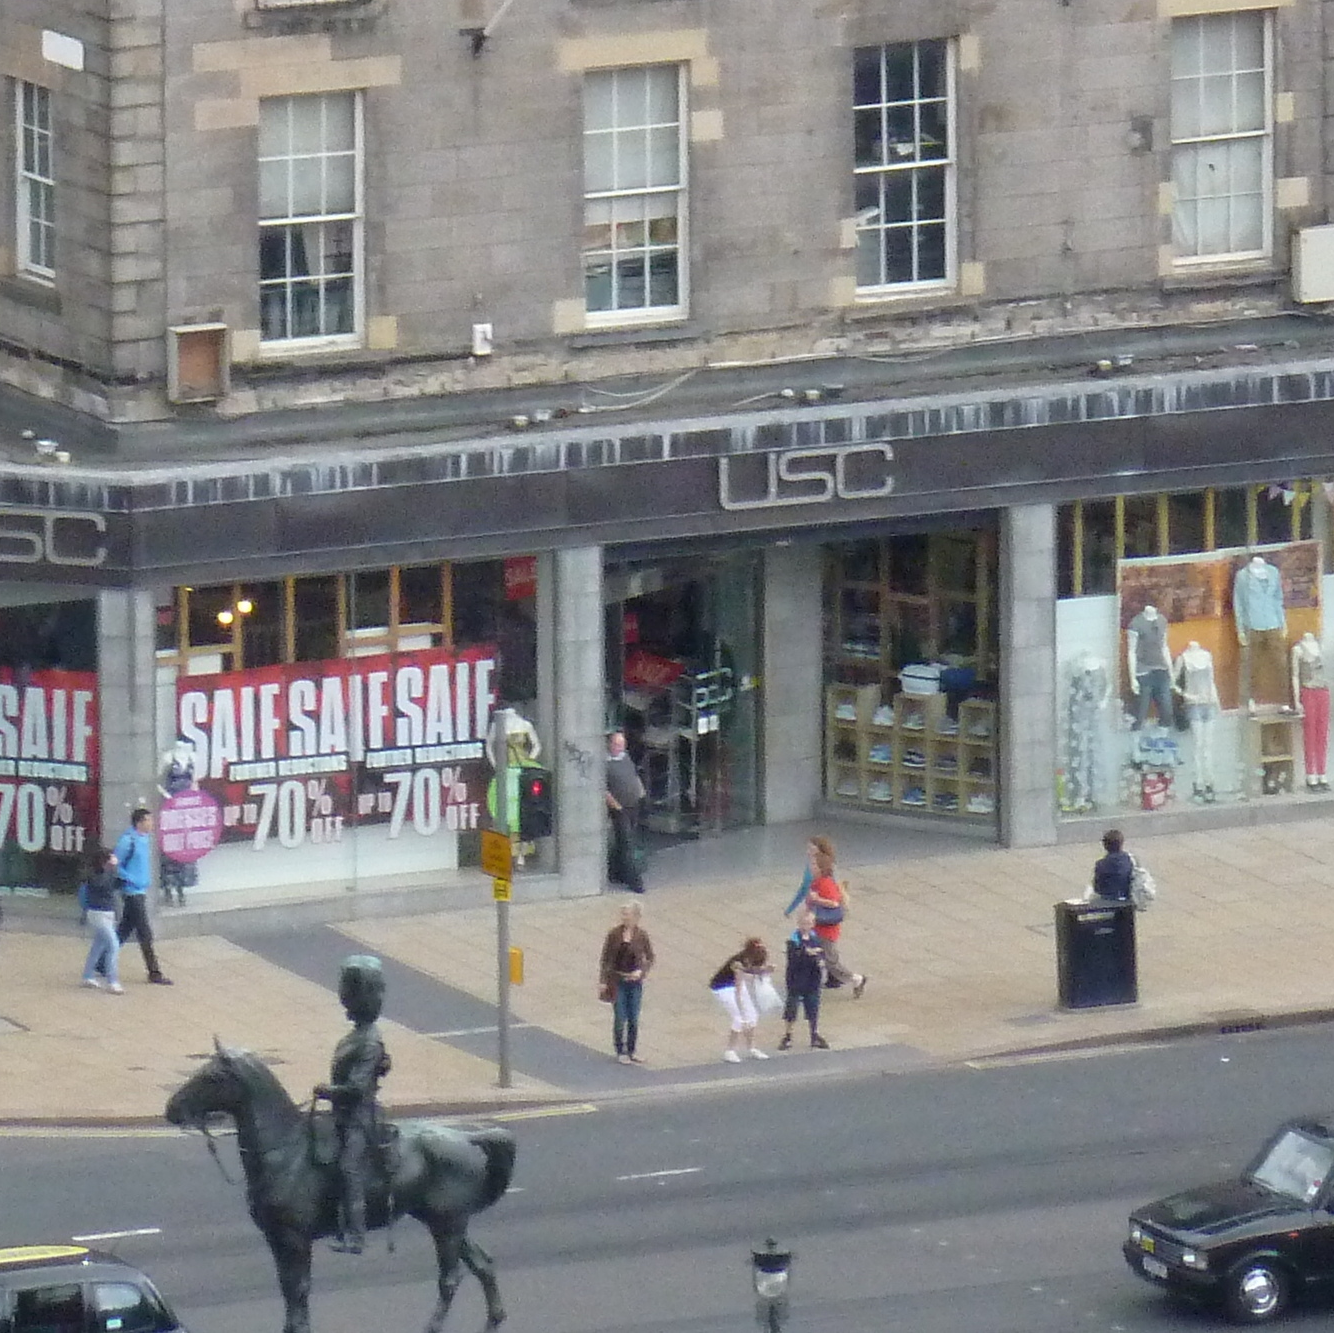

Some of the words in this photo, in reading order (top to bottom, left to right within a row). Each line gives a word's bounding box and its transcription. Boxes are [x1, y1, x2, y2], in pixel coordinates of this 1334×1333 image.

[719, 442, 895, 511] USC
[180, 680, 280, 781] SALE
[289, 670, 389, 762] SALE
[396, 659, 496, 747] SALE
[312, 816, 345, 844] OFF
[446, 803, 480, 831] OFF
[50, 825, 87, 853] OFF
